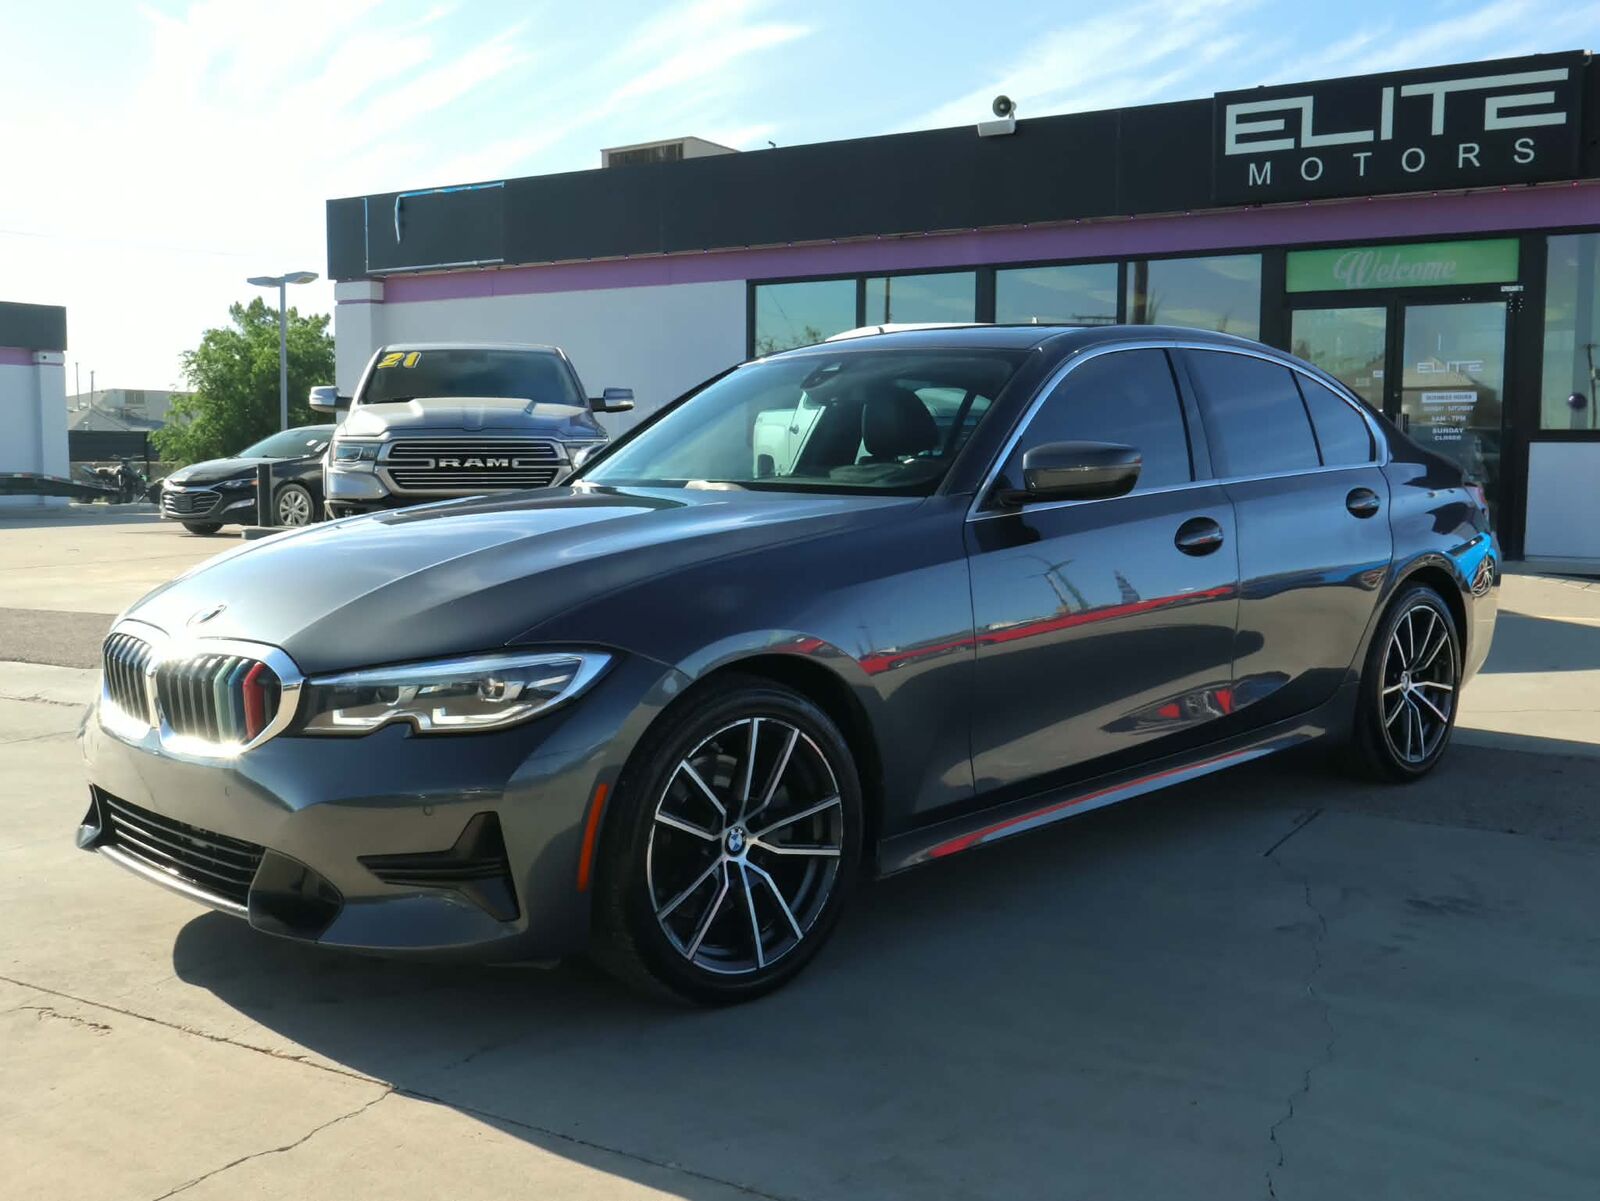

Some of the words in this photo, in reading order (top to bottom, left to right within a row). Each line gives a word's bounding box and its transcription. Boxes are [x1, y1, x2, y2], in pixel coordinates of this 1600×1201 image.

[1225, 68, 1569, 155] ELITE
[1249, 138, 1535, 186] MOTORS
[1334, 251, 1456, 288] Welcome
[377, 352, 421, 369] 21
[1417, 361, 1483, 373] ELITE
[439, 458, 509, 467] RAM
